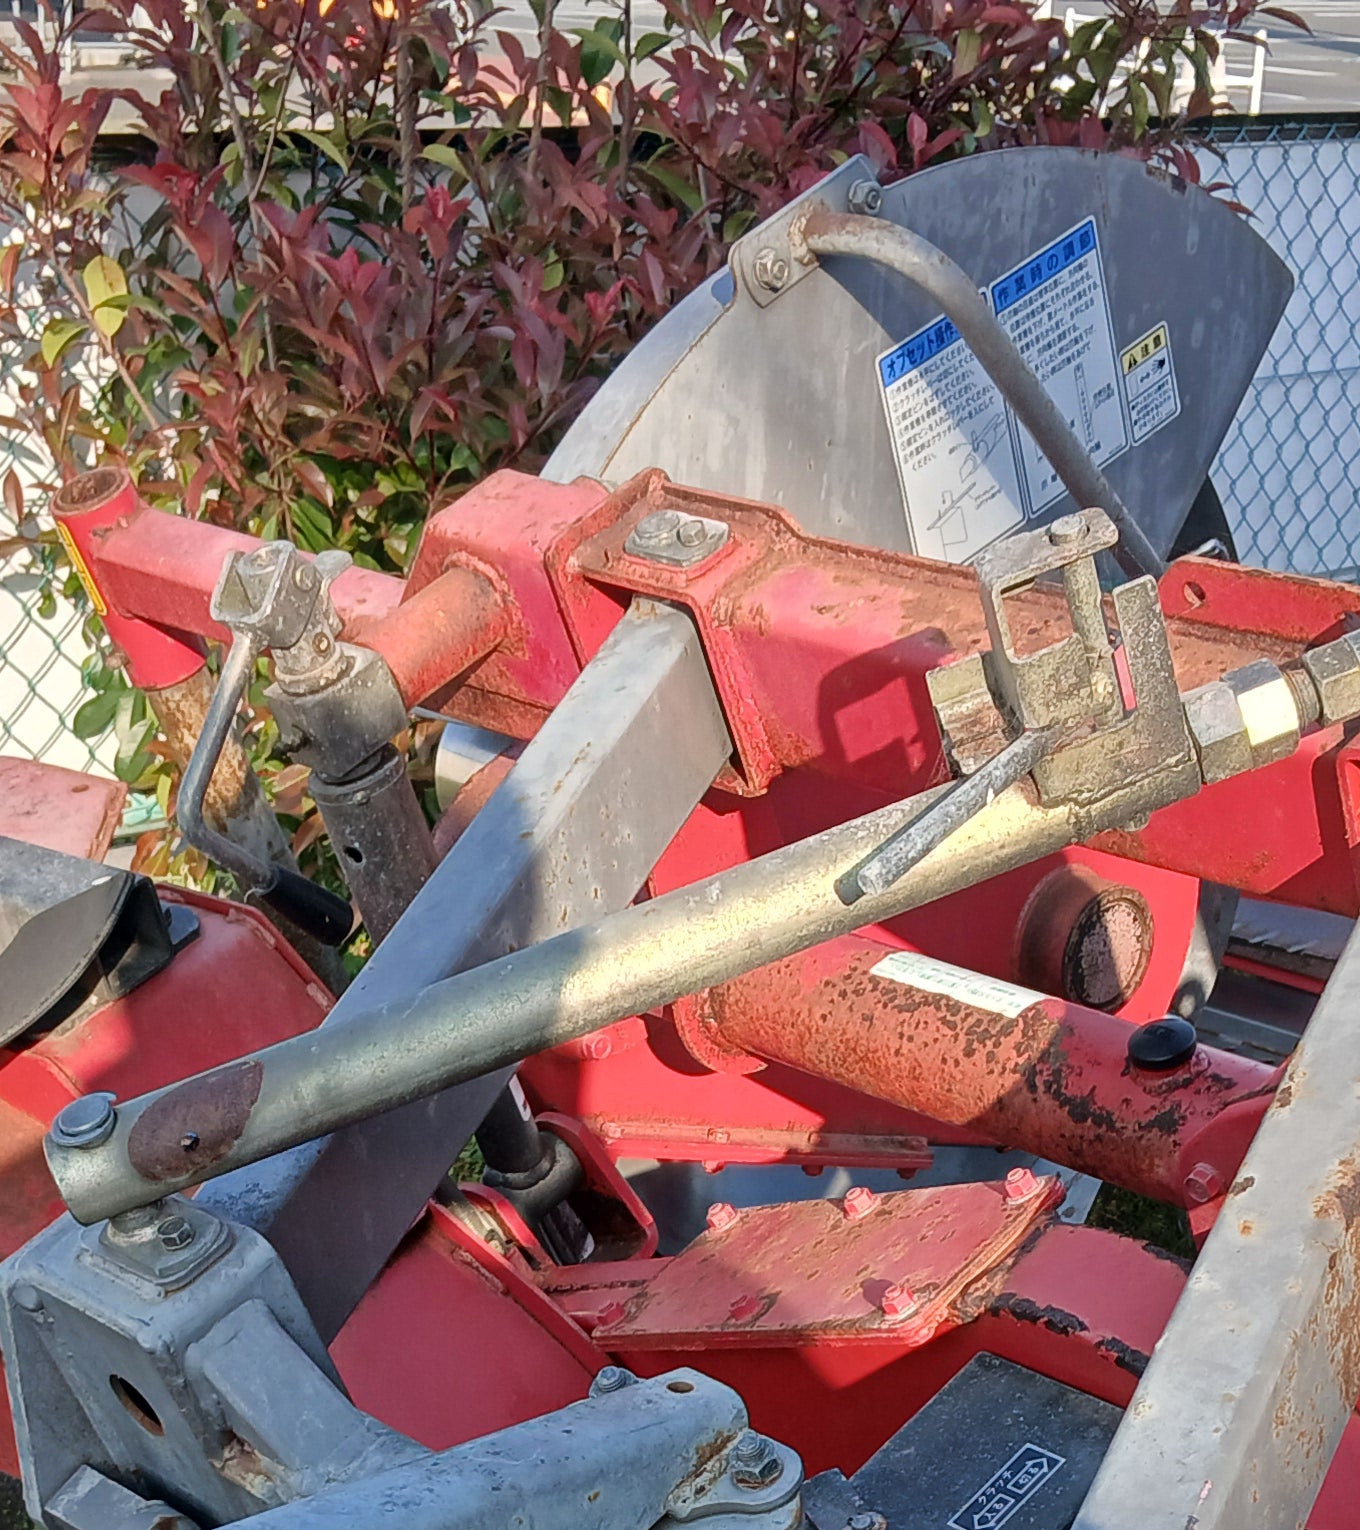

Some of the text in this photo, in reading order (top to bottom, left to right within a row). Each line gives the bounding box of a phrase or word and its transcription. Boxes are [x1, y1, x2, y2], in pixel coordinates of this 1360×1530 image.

[1019, 1467, 1040, 1484] 切る
[978, 1470, 1014, 1505] クラッチ
[984, 1503, 1004, 1521] 入る
